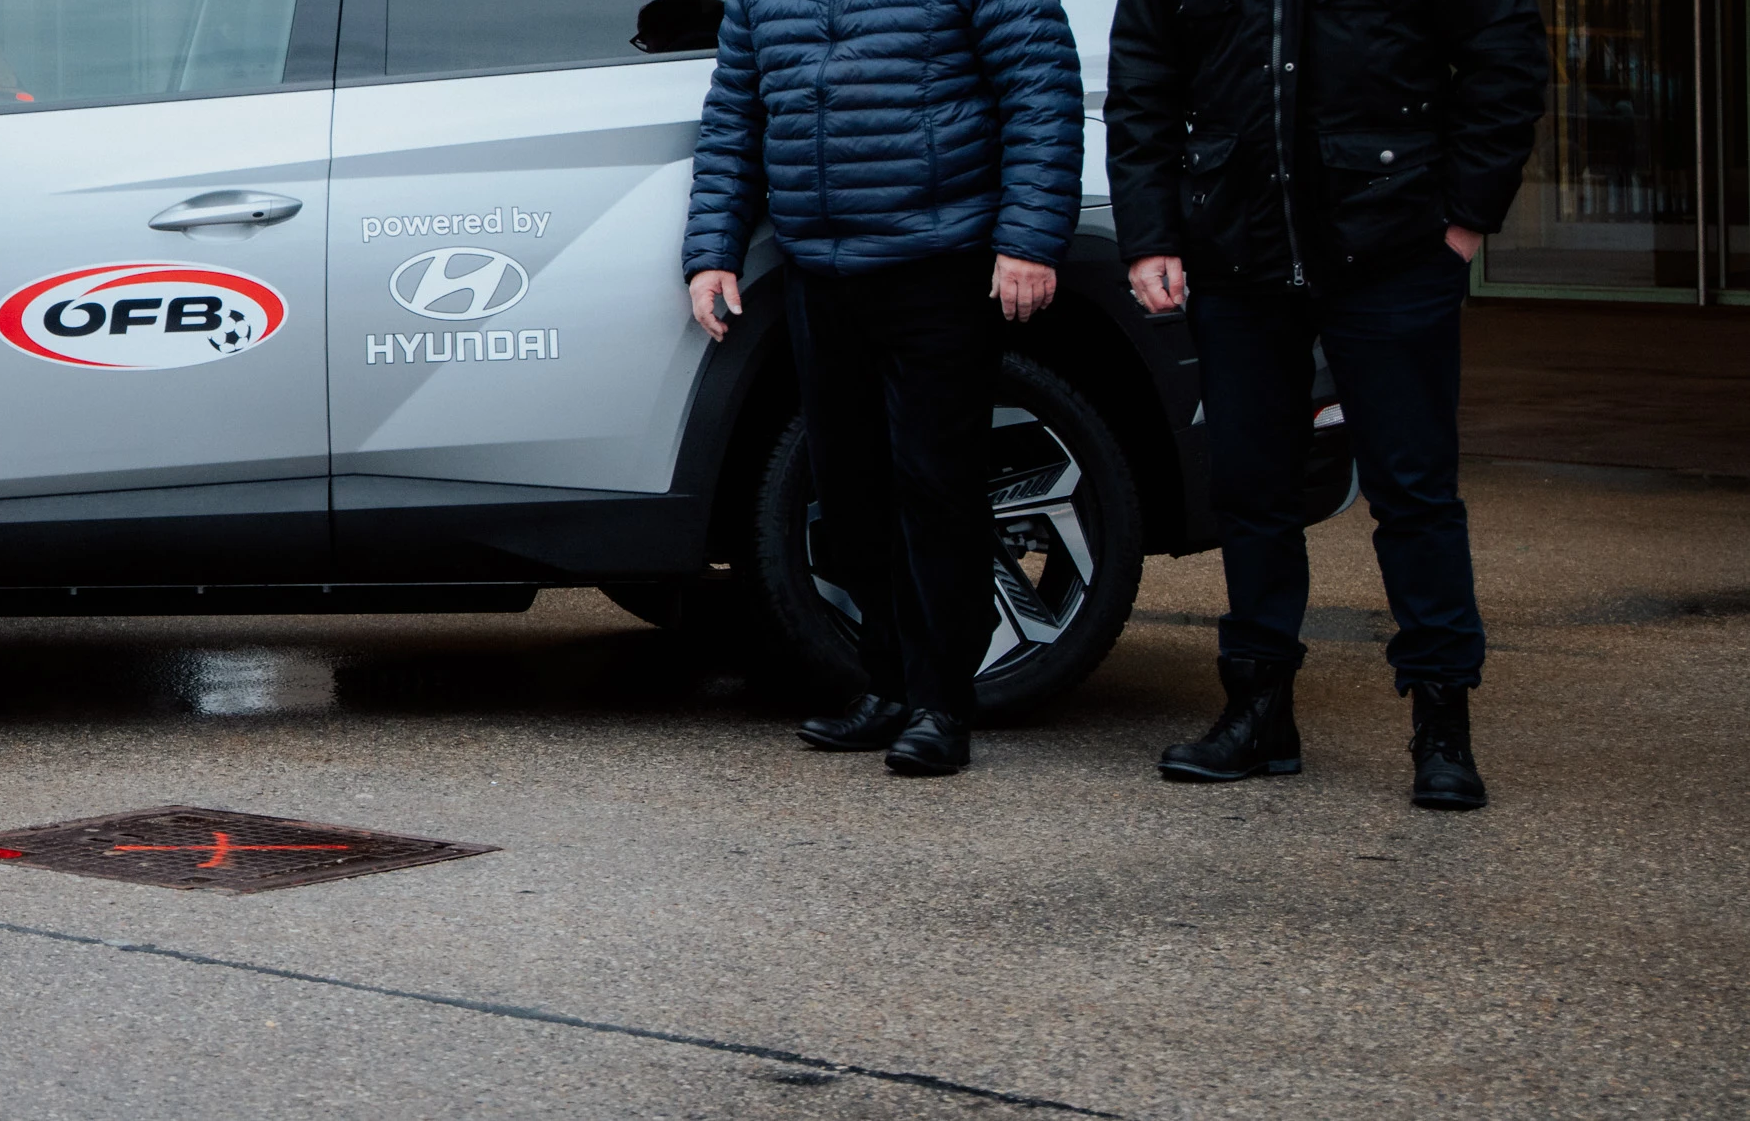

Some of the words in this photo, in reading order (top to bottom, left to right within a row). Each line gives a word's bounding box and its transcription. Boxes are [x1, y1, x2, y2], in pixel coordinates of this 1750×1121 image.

[361, 207, 503, 243] powered
[511, 206, 551, 238] by
[366, 328, 559, 365] HYUNDAI
